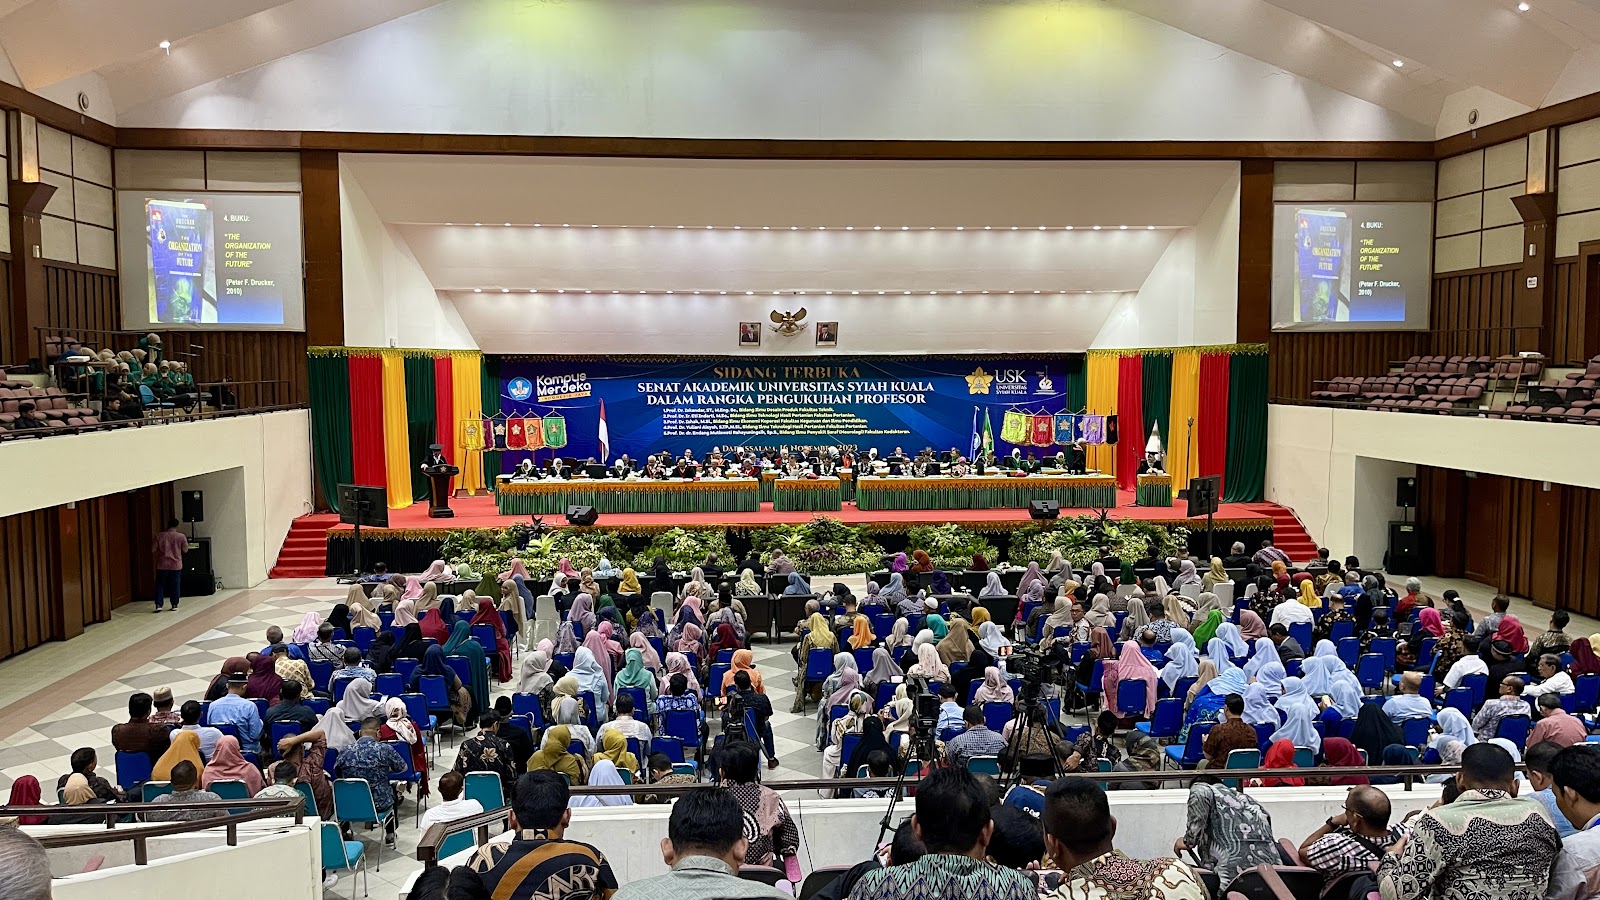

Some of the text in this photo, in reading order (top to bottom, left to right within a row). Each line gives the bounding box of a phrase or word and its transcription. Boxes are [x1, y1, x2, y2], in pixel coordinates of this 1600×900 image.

[168, 241, 202, 252] ORGANIZATION
[177, 258, 194, 266] FUTURE
[226, 288, 243, 296] 2010)
[714, 366, 861, 379] SIDANG TERBUKA
[995, 370, 1028, 383] USK
[536, 372, 586, 387] Kampus
[536, 382, 592, 396] Merdeka
[637, 382, 935, 392] SENAT AKADEMIK UNIVERSITAS SYIAH KUALA
[647, 394, 926, 404] DALAM RANGKA PENGUKUHAN PROFESOR
[838, 442, 858, 452] 2023
